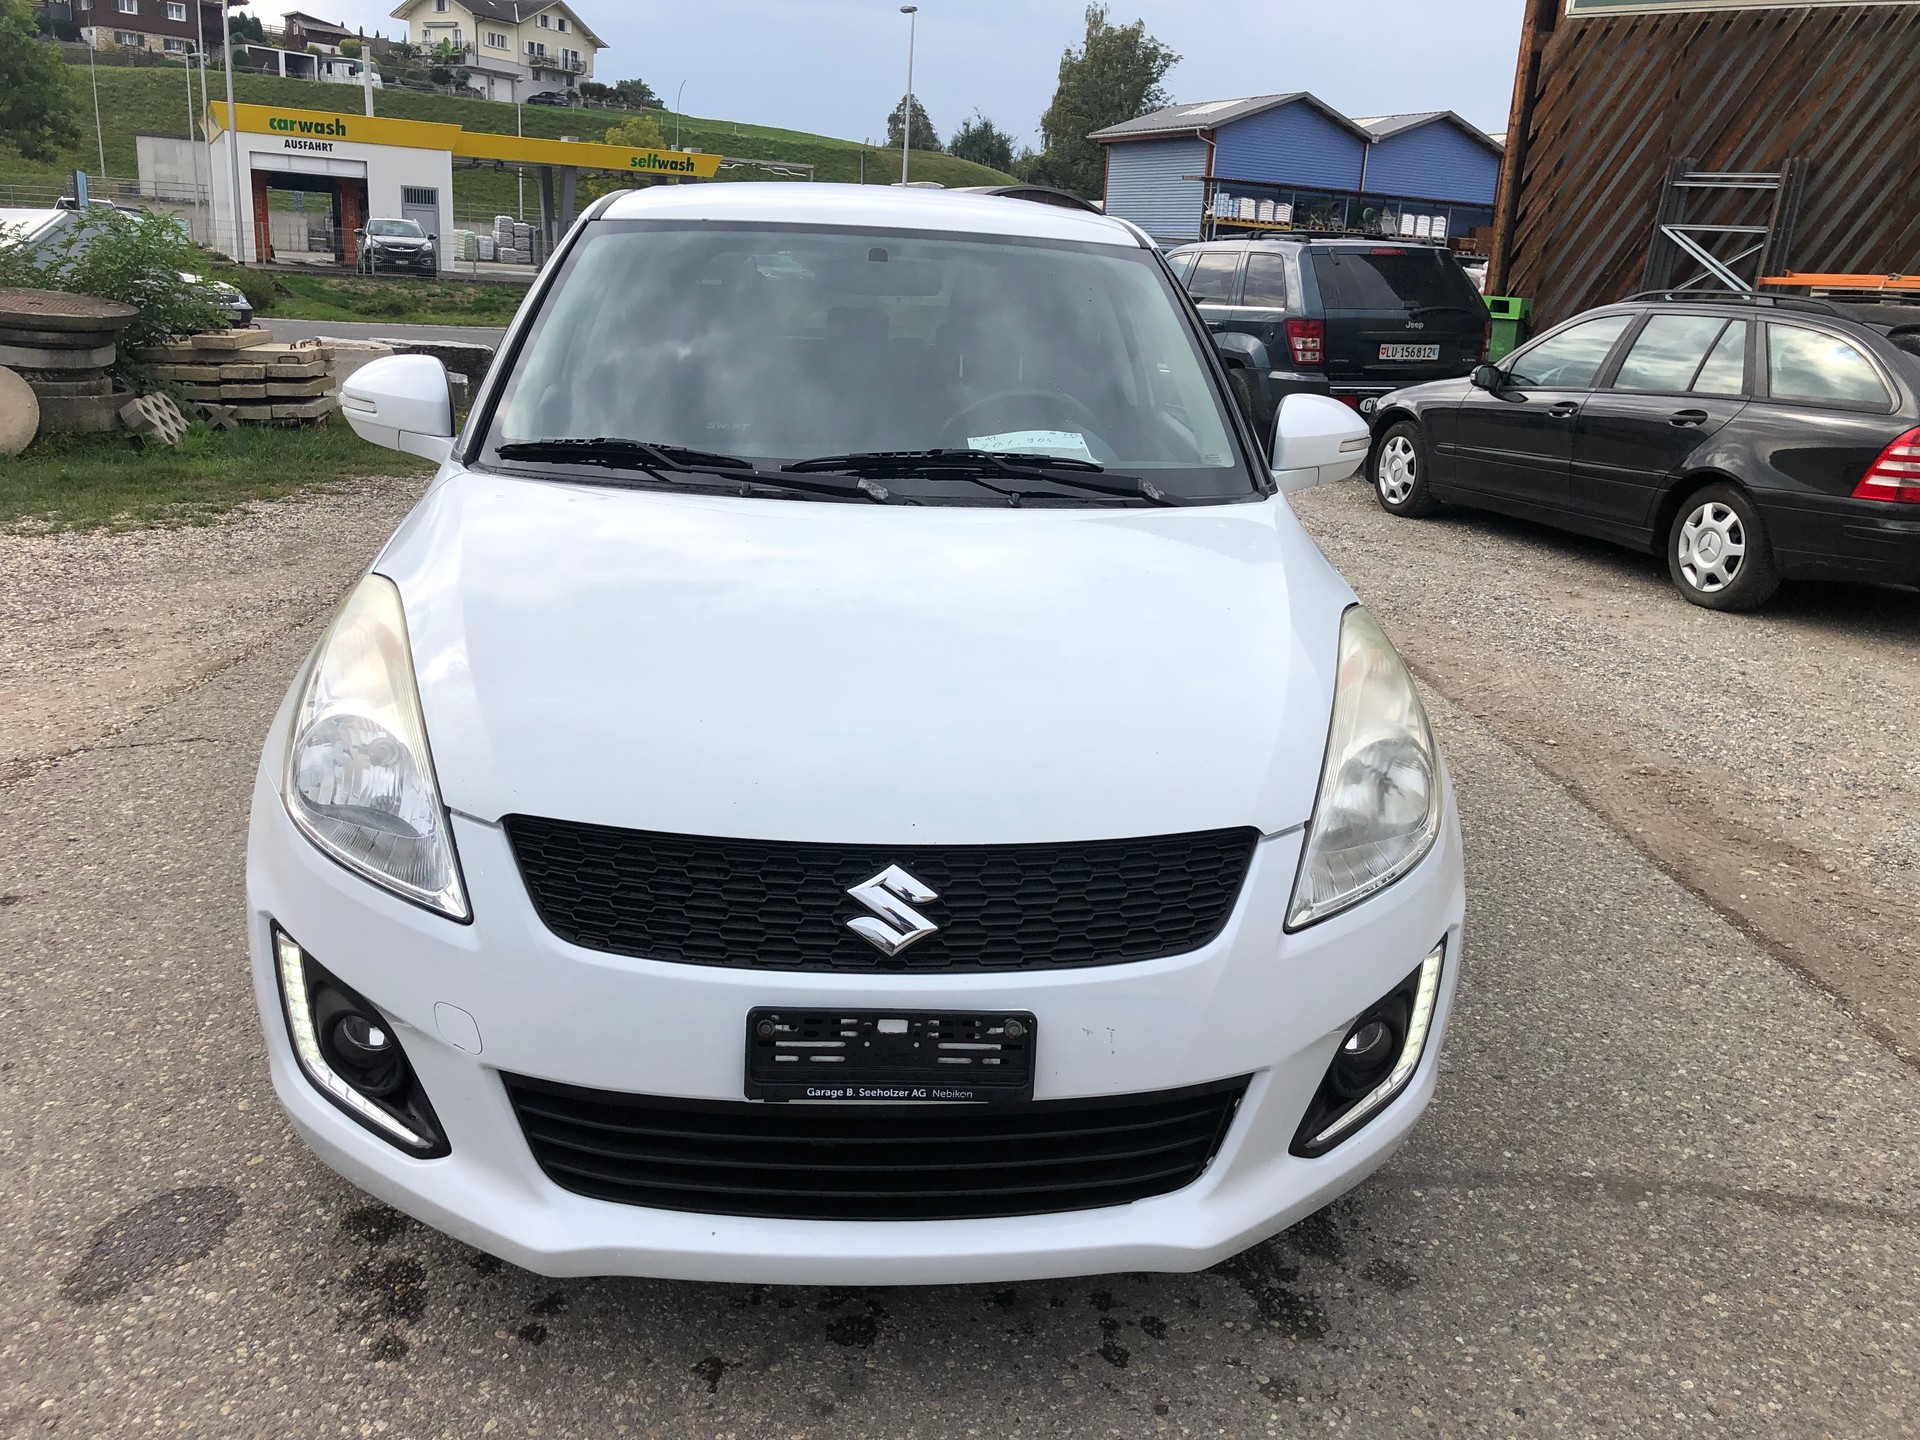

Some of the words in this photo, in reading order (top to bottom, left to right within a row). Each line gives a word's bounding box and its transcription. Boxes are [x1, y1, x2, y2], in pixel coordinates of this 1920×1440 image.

[269, 117, 346, 136] carwash
[284, 139, 333, 152] AUSFAHRT
[630, 153, 695, 172] selfwash
[1405, 320, 1424, 330] Jeep
[806, 1087, 844, 1098] Garage
[846, 1088, 856, 1097] B.
[859, 1088, 909, 1097] Seeholzer
[911, 1089, 927, 1097] AG
[932, 1089, 973, 1098] Nebikon
